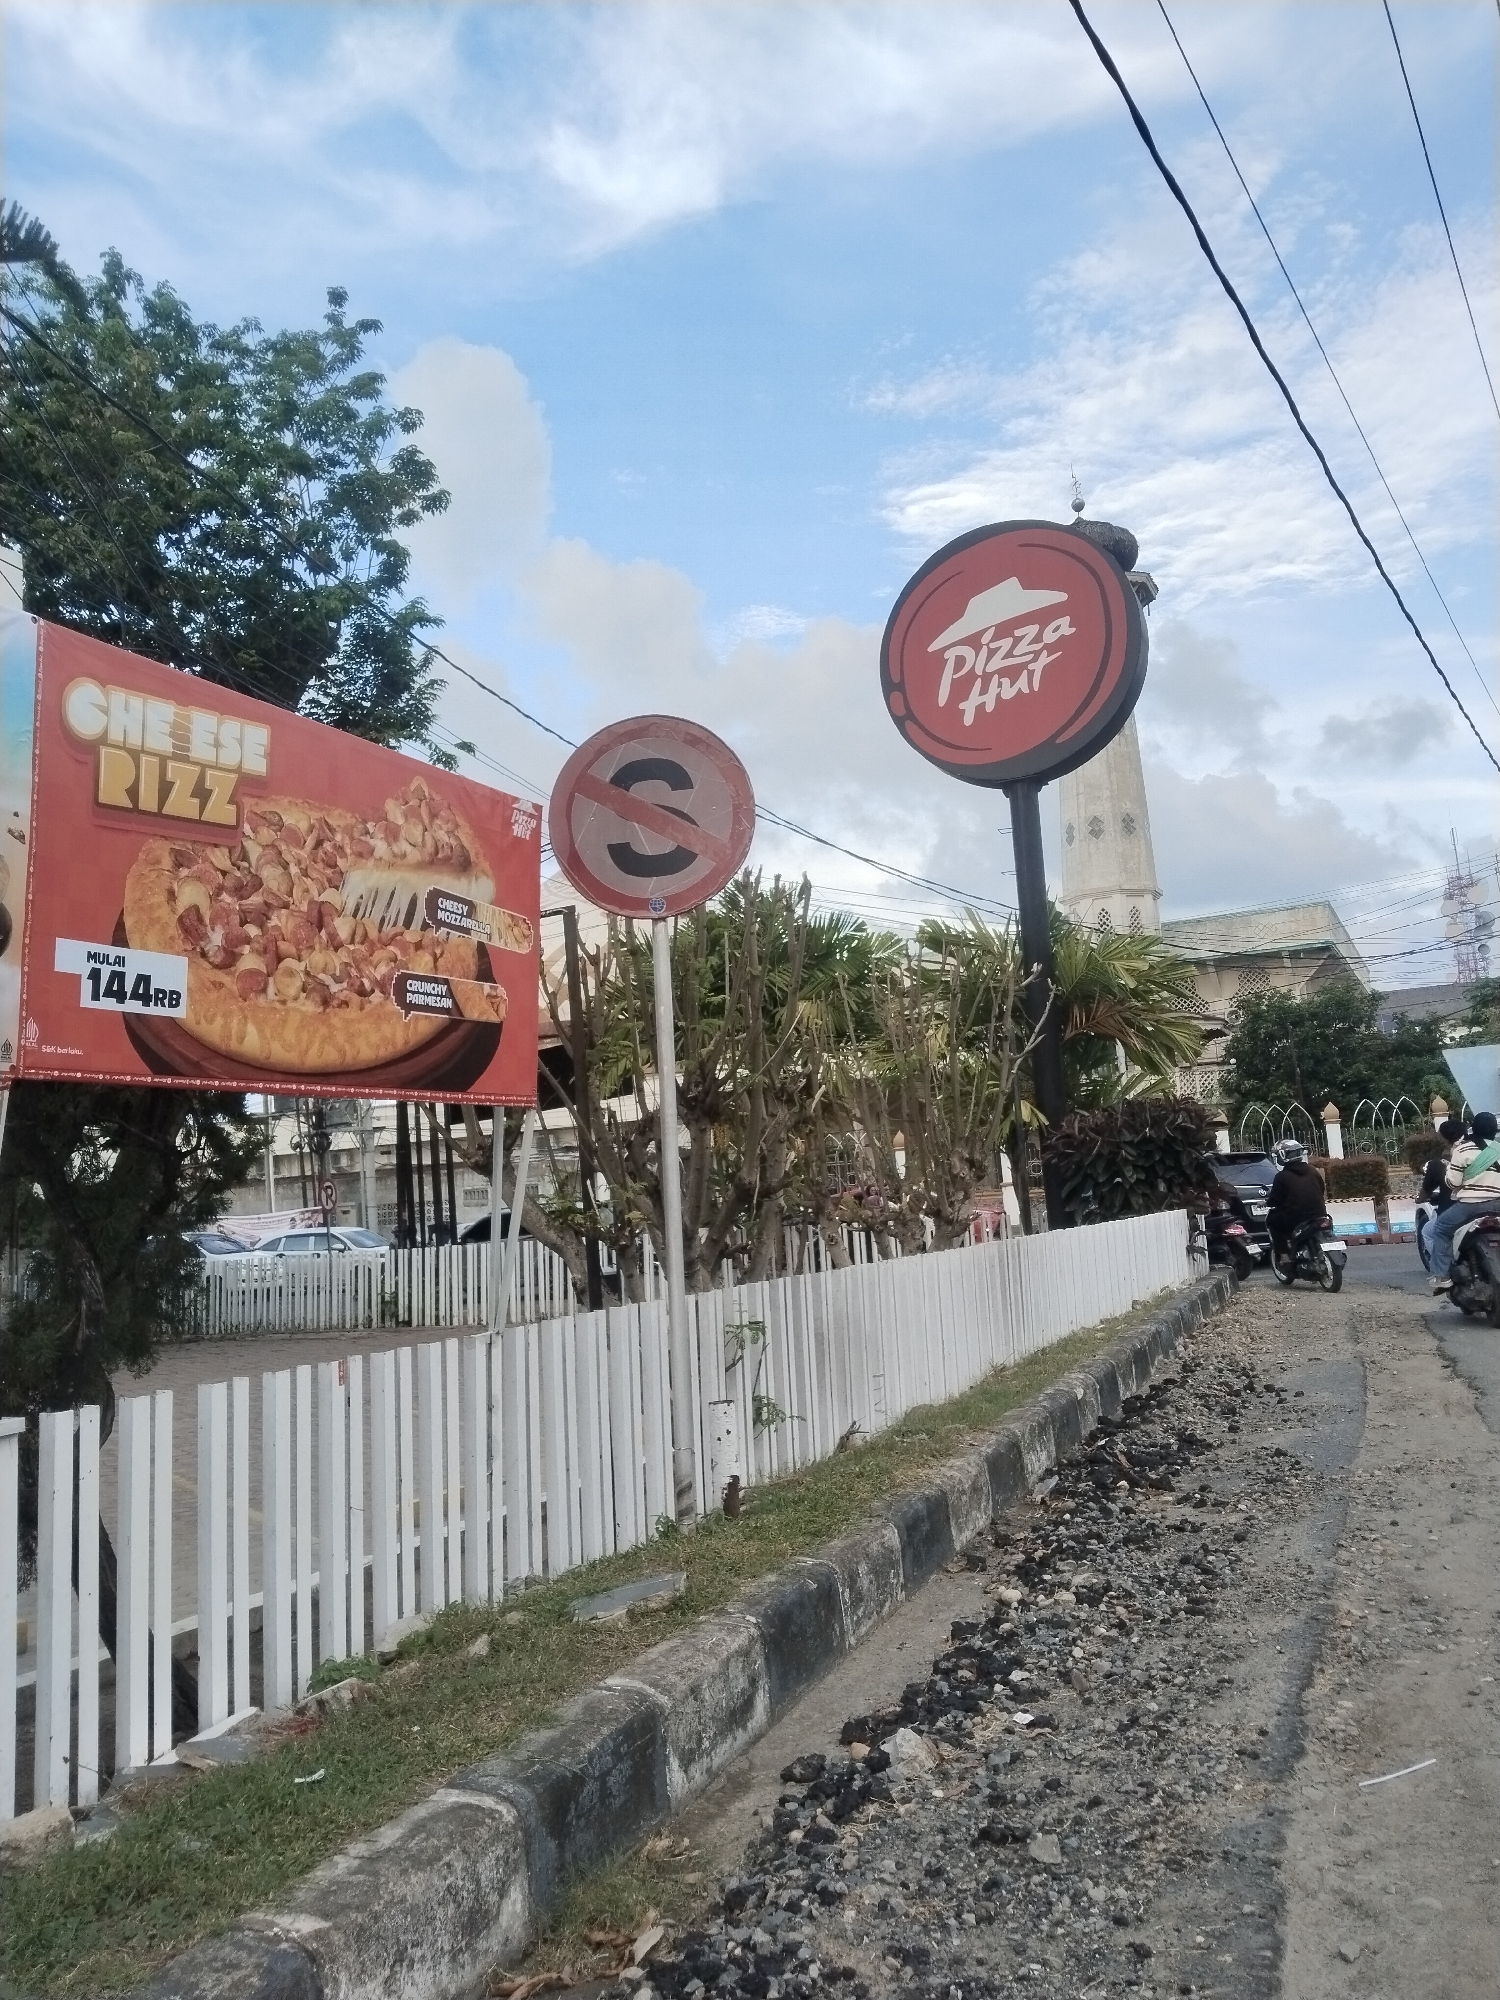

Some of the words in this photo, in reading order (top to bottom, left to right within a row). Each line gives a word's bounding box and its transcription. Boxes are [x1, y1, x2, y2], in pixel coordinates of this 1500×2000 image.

[938, 616, 1076, 707] Pizza
[958, 650, 1063, 727] Hut
[63, 677, 270, 777] CHEESE
[98, 746, 239, 826] RIZZ
[511, 809, 538, 830] Pizza
[607, 757, 701, 877] S
[437, 897, 469, 916] CHEESY
[437, 908, 491, 935] MOZZARELLA
[86, 950, 126, 968] MULAI
[86, 966, 182, 1009] 144RB
[406, 979, 448, 996] CRUNCHY
[406, 992, 453, 1009] PARMESAN
[324, 1184, 334, 1207] P
